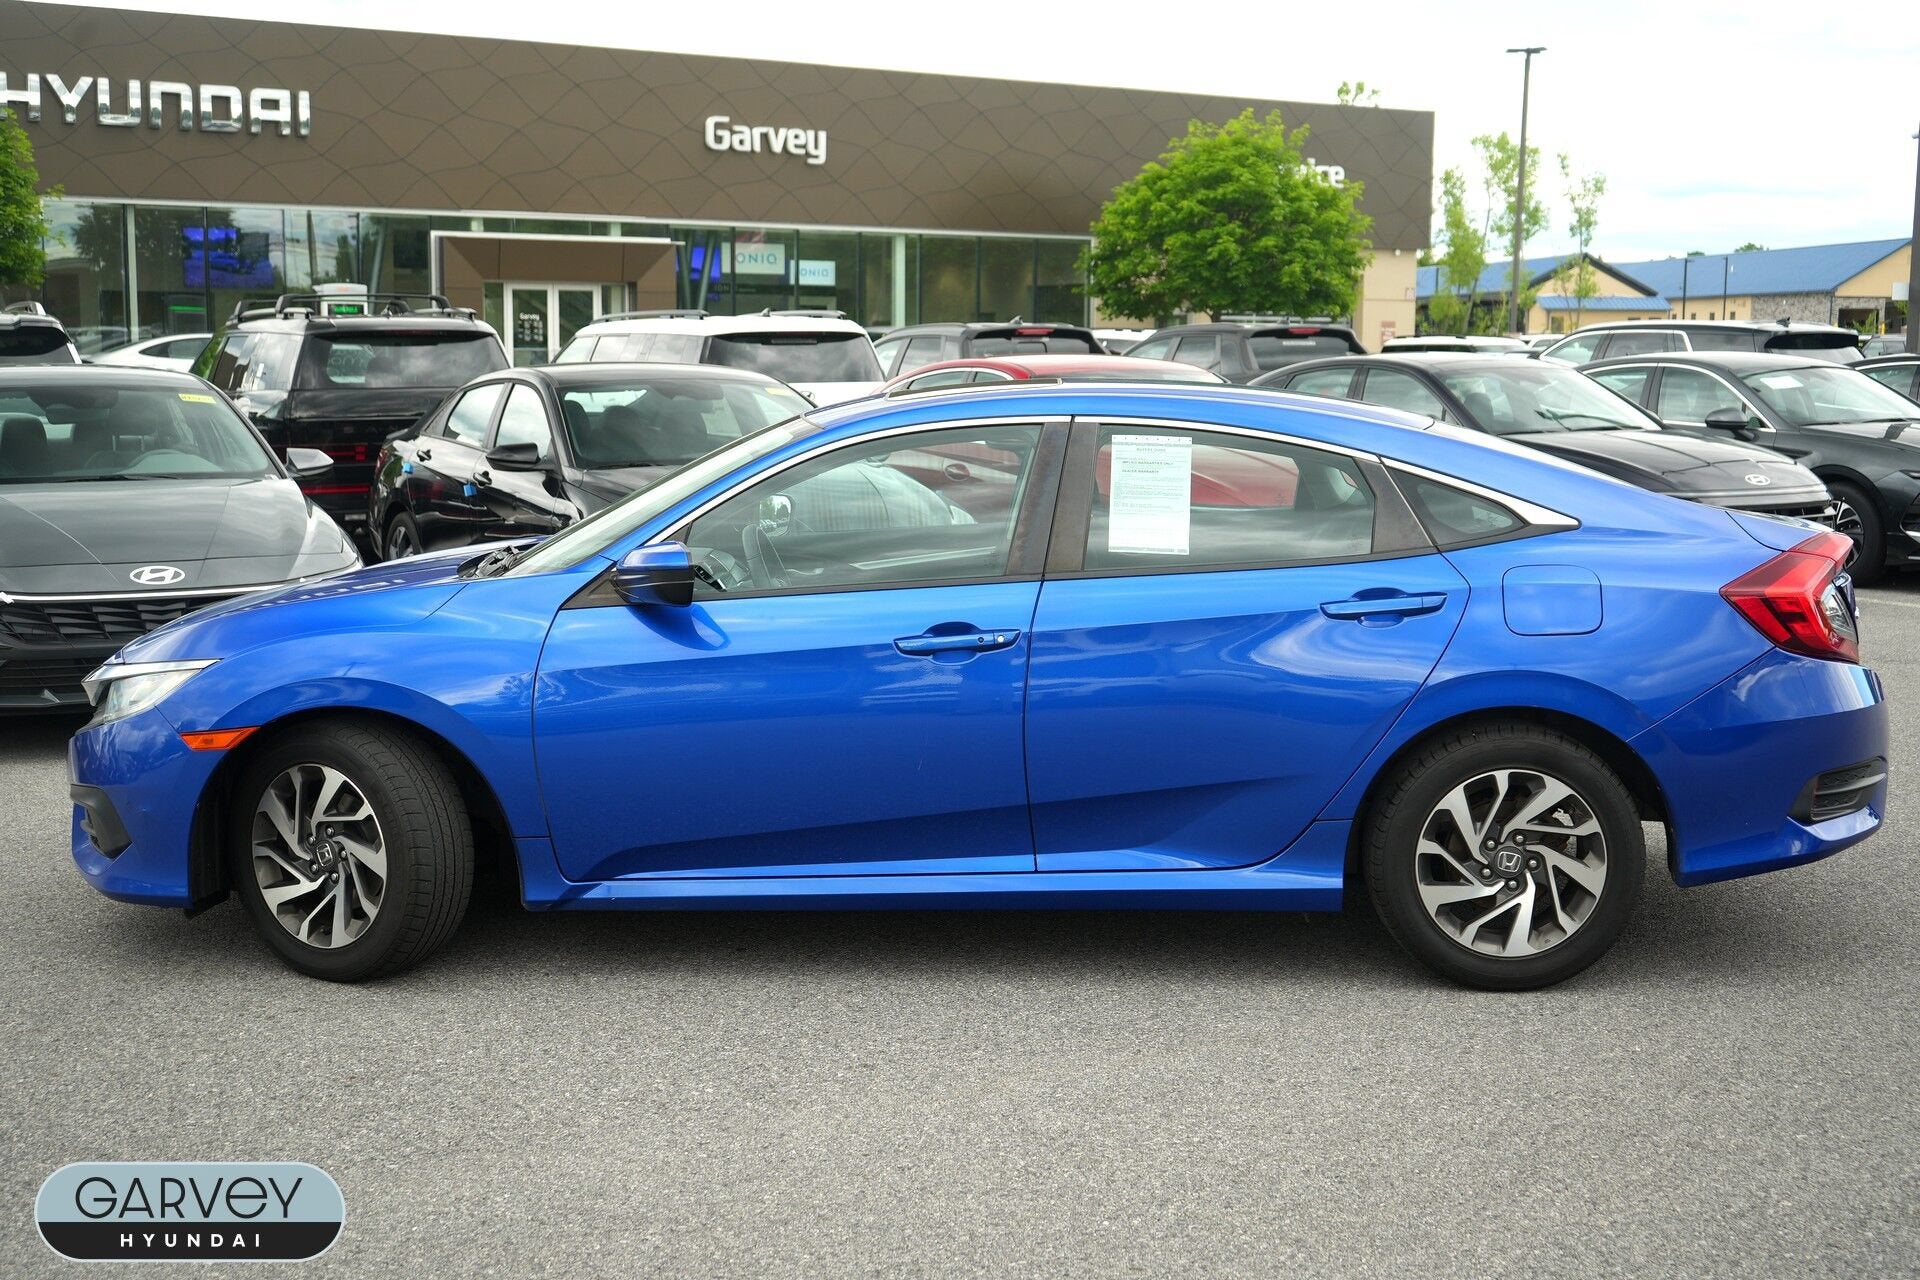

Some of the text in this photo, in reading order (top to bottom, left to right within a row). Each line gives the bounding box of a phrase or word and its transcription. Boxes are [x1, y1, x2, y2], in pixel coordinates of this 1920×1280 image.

[0, 71, 310, 137] HYUNDAI
[705, 115, 827, 165] Garvey
[735, 253, 777, 264] ONIQ
[800, 267, 829, 277] ONIQ
